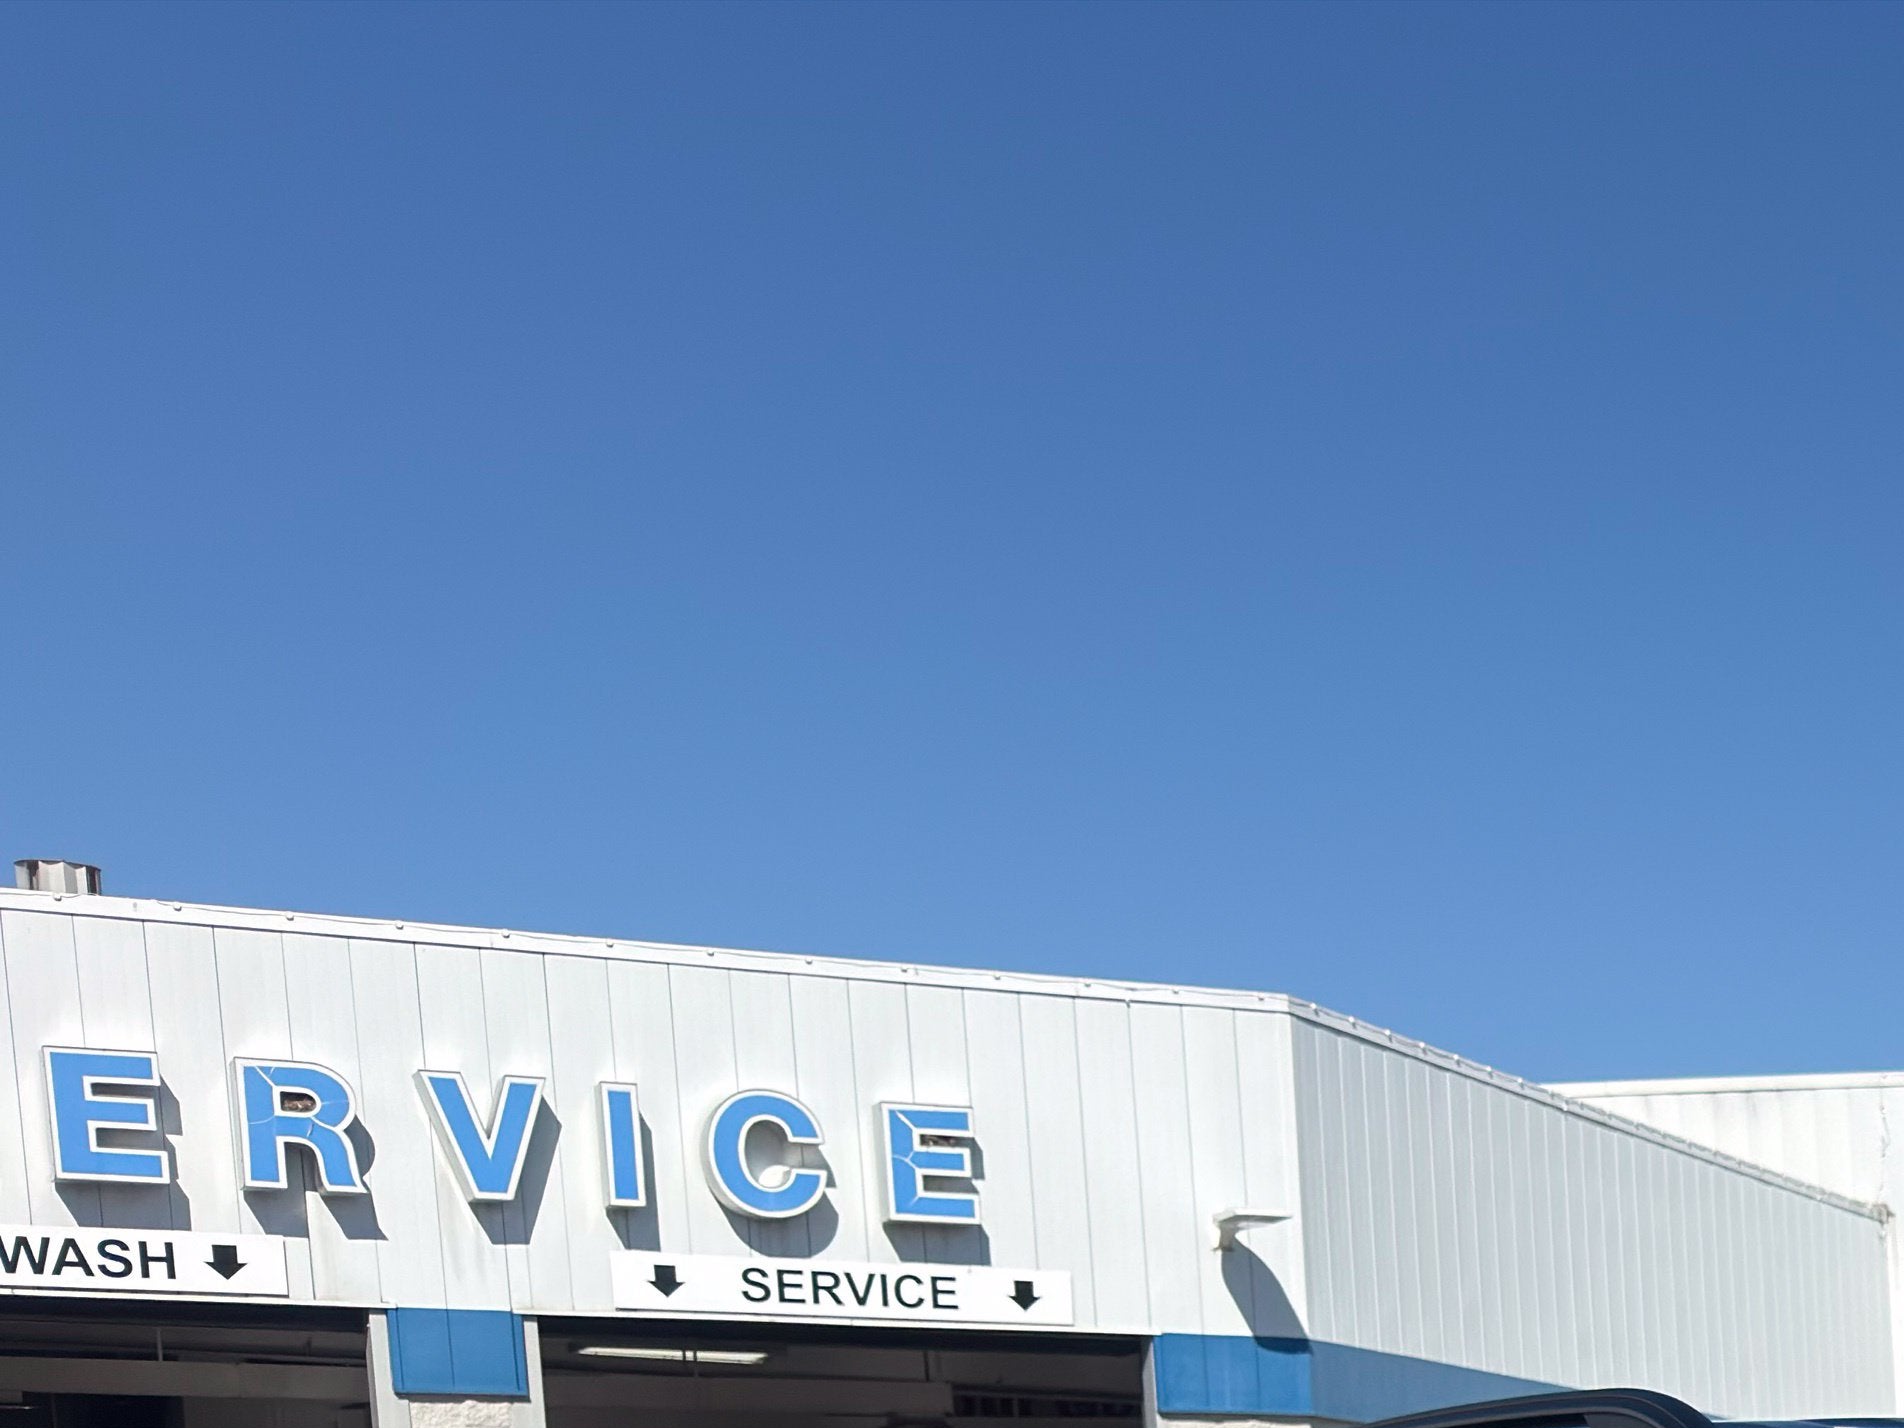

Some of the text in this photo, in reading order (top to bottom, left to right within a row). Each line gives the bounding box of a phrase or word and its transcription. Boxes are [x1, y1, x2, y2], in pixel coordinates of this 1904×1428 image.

[42, 1046, 985, 1225] ERVICE
[0, 1235, 176, 1280] WASH
[741, 1267, 959, 1310] SERVICE
